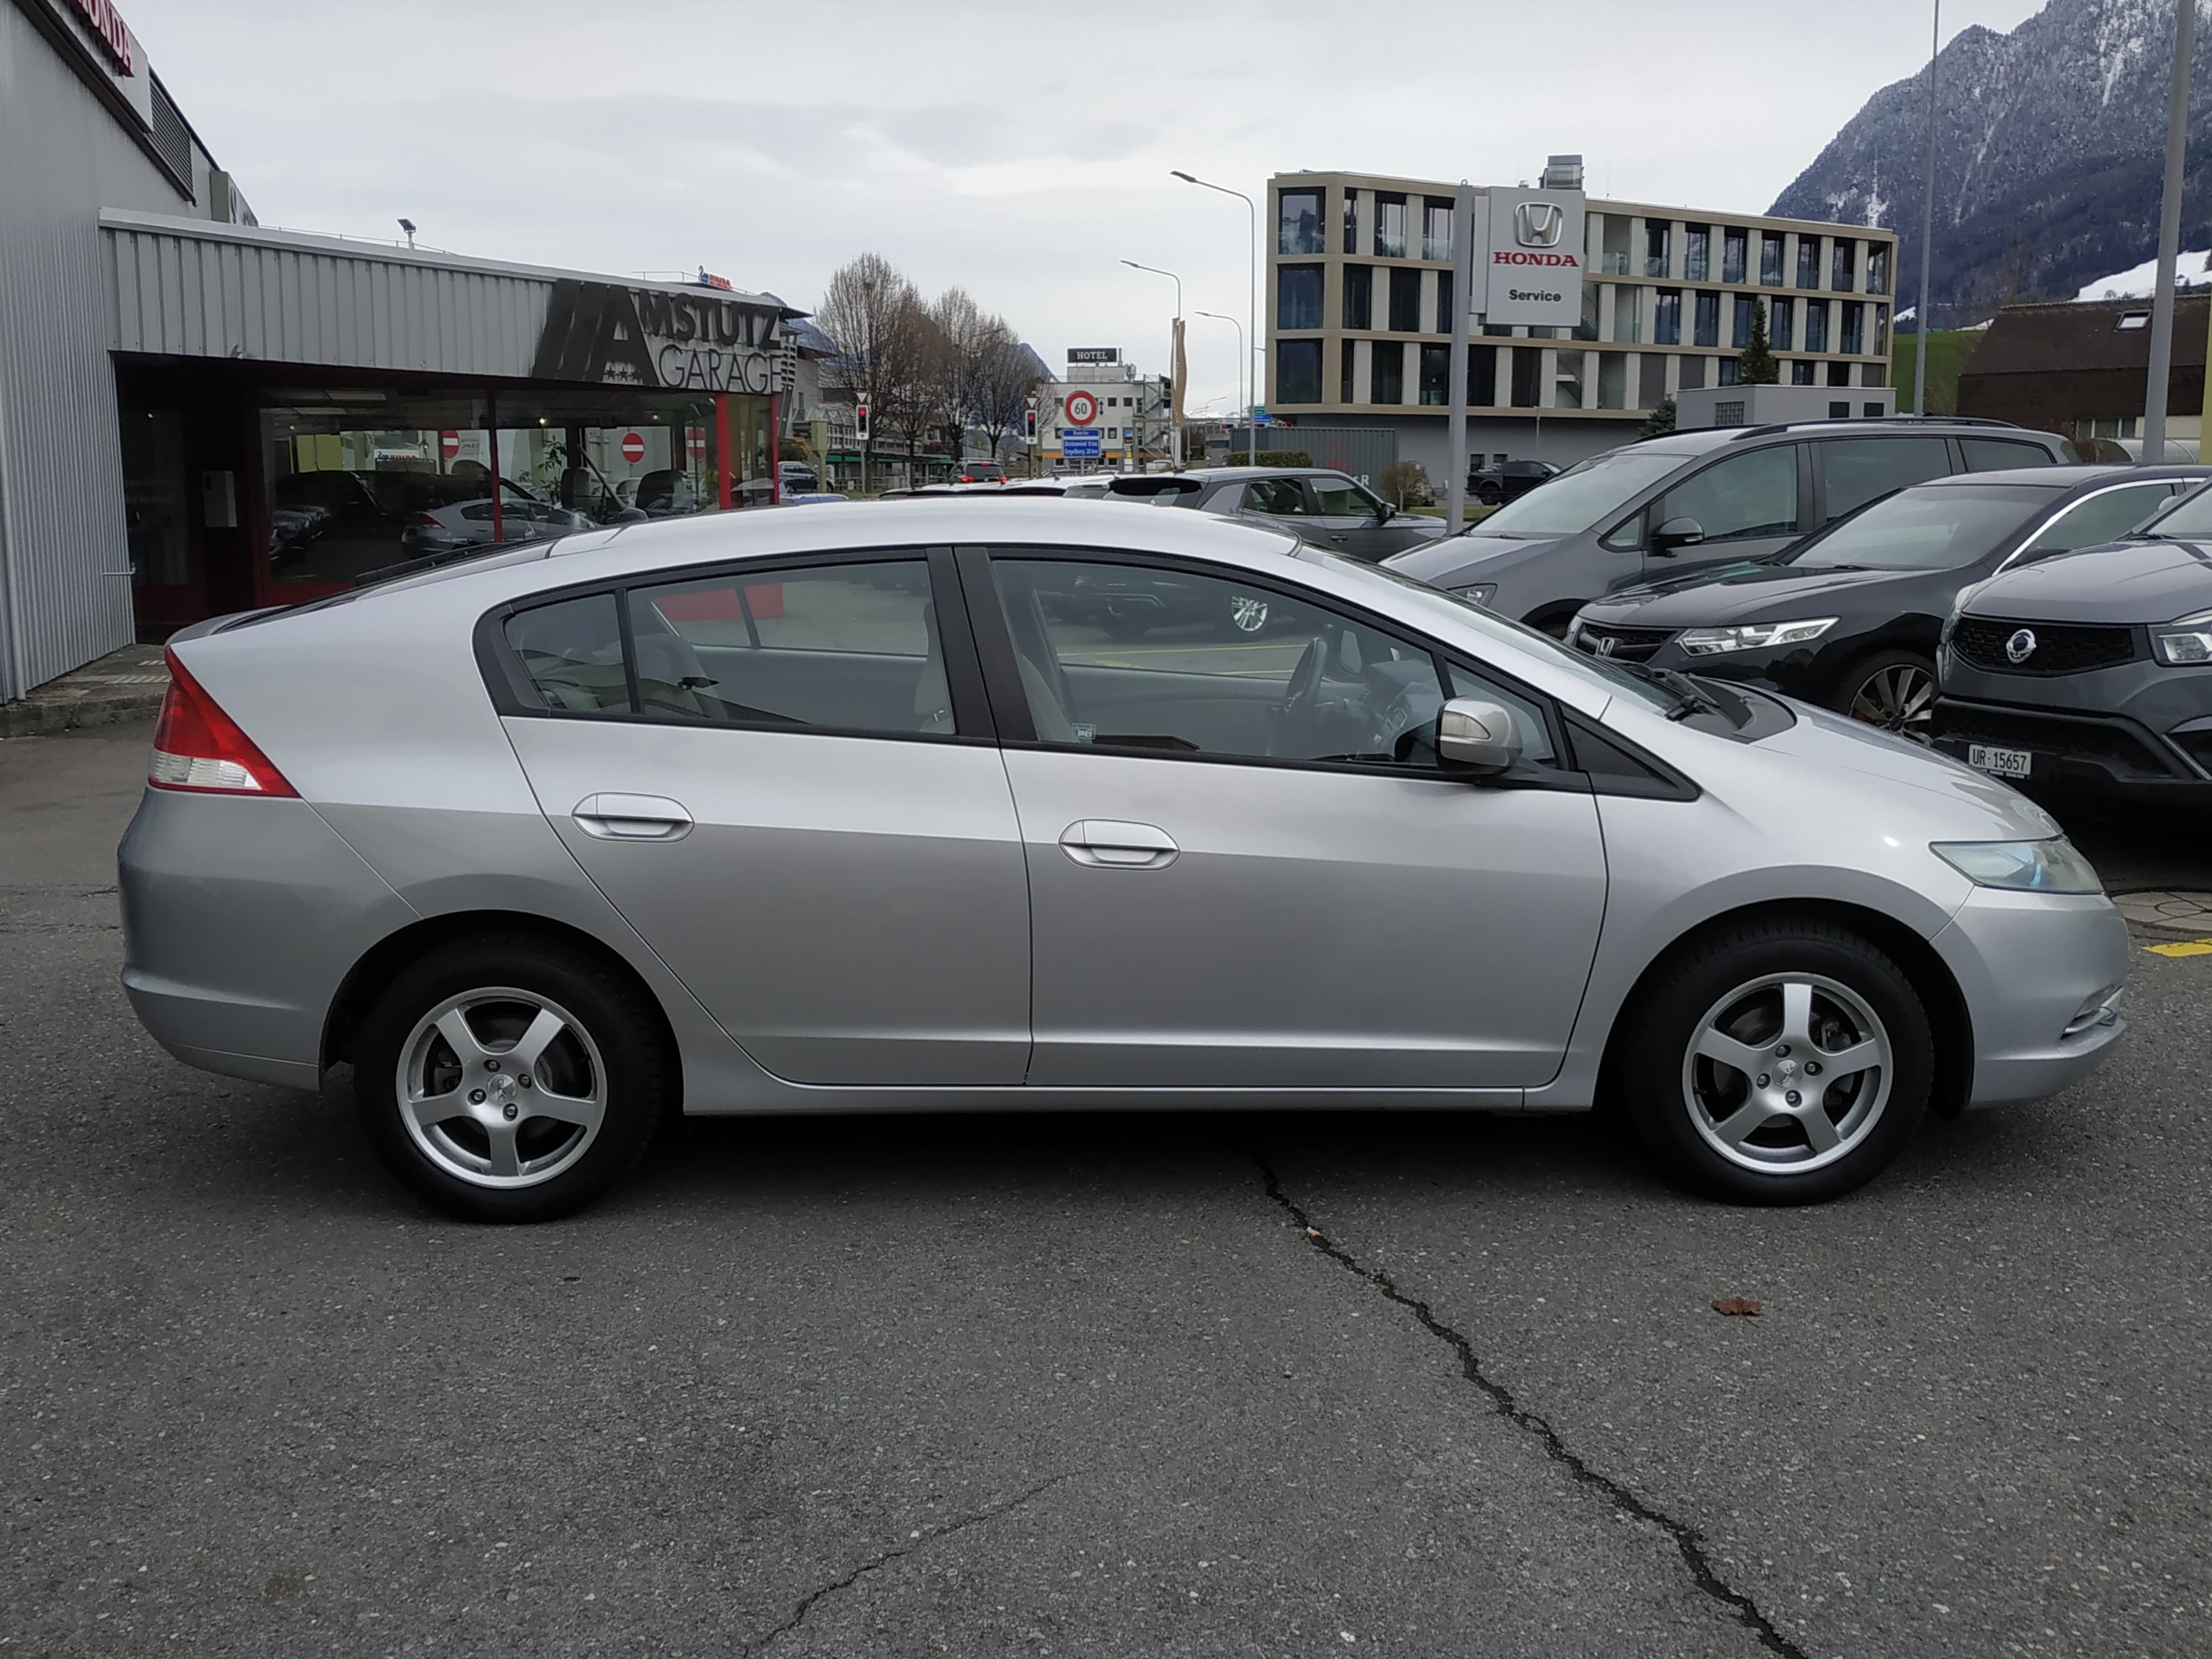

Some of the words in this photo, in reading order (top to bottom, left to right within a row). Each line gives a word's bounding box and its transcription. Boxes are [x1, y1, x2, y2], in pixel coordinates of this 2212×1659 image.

[78, 0, 134, 76] ONDA
[1493, 252, 1579, 268] HONDA
[1509, 289, 1562, 302] Service
[583, 284, 781, 385] AMSTUTZ
[1077, 351, 1108, 359] HOTEL
[659, 343, 782, 395] GARAGE
[1074, 402, 1087, 415] 60
